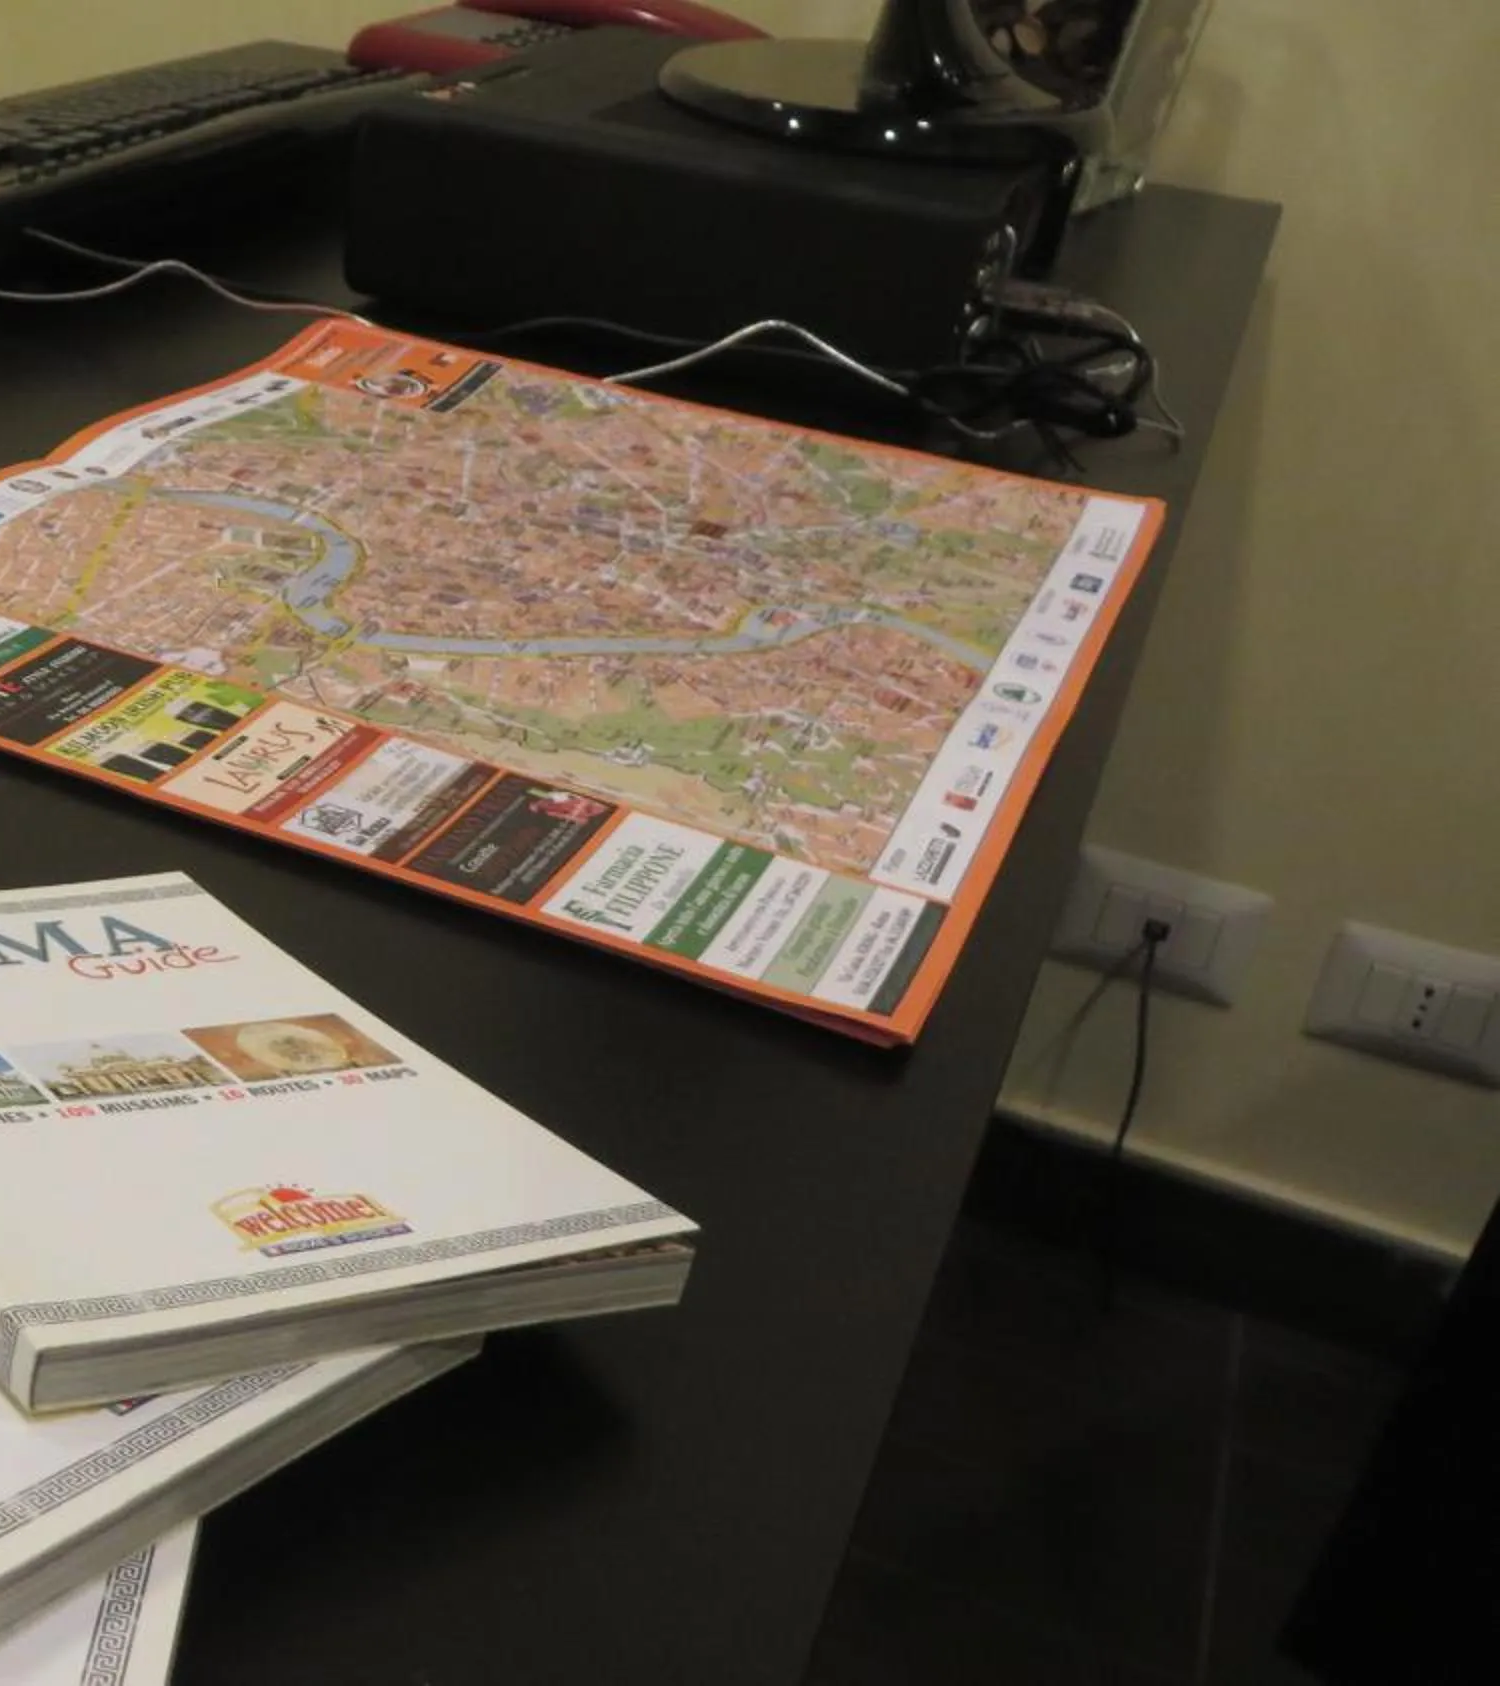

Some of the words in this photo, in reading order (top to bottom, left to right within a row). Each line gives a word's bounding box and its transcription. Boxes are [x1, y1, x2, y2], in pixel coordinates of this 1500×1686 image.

[604, 842, 686, 918] FILIPPONE
[66, 943, 240, 981] Guide
[99, 1093, 200, 1116] MUSEUMS
[247, 1079, 321, 1098] ROUTES
[369, 1066, 419, 1083] MAPS
[233, 1192, 388, 1238] welcome!
